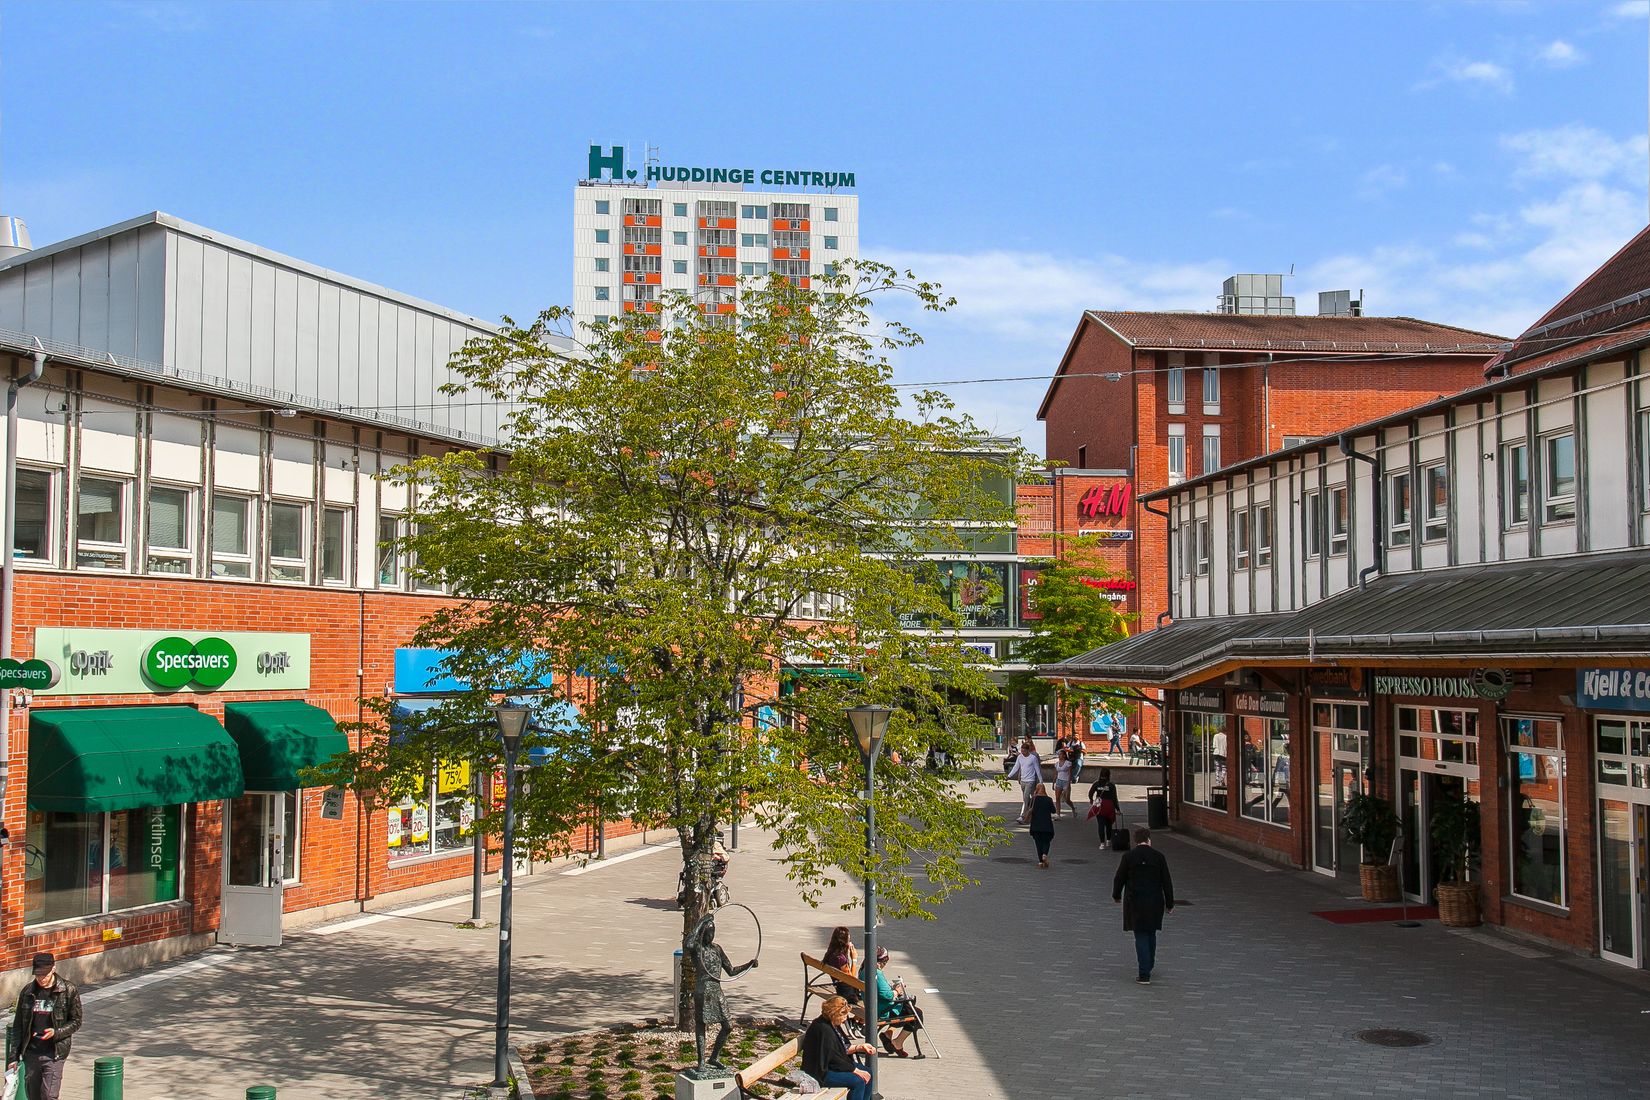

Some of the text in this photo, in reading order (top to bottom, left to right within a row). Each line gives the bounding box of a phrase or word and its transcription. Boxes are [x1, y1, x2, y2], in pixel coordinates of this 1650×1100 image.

[589, 145, 624, 180] H
[647, 166, 856, 187] HUDDINGE CENTRUM
[1081, 483, 1132, 518] H&M
[1099, 592, 1127, 602] Ingång
[899, 613, 914, 621] GET
[900, 620, 922, 628] MORE
[76, 650, 114, 672] Optik
[156, 650, 230, 673] Specsavers
[262, 651, 291, 671] Optik
[1375, 676, 1430, 696] ESPRESSO
[1583, 668, 1619, 701] Kjell
[1620, 670, 1632, 697] &
[1249, 696, 1259, 711] Don
[1260, 696, 1285, 713] Giovanni
[445, 771, 462, 786] 75%
[389, 823, 401, 835] 0%
